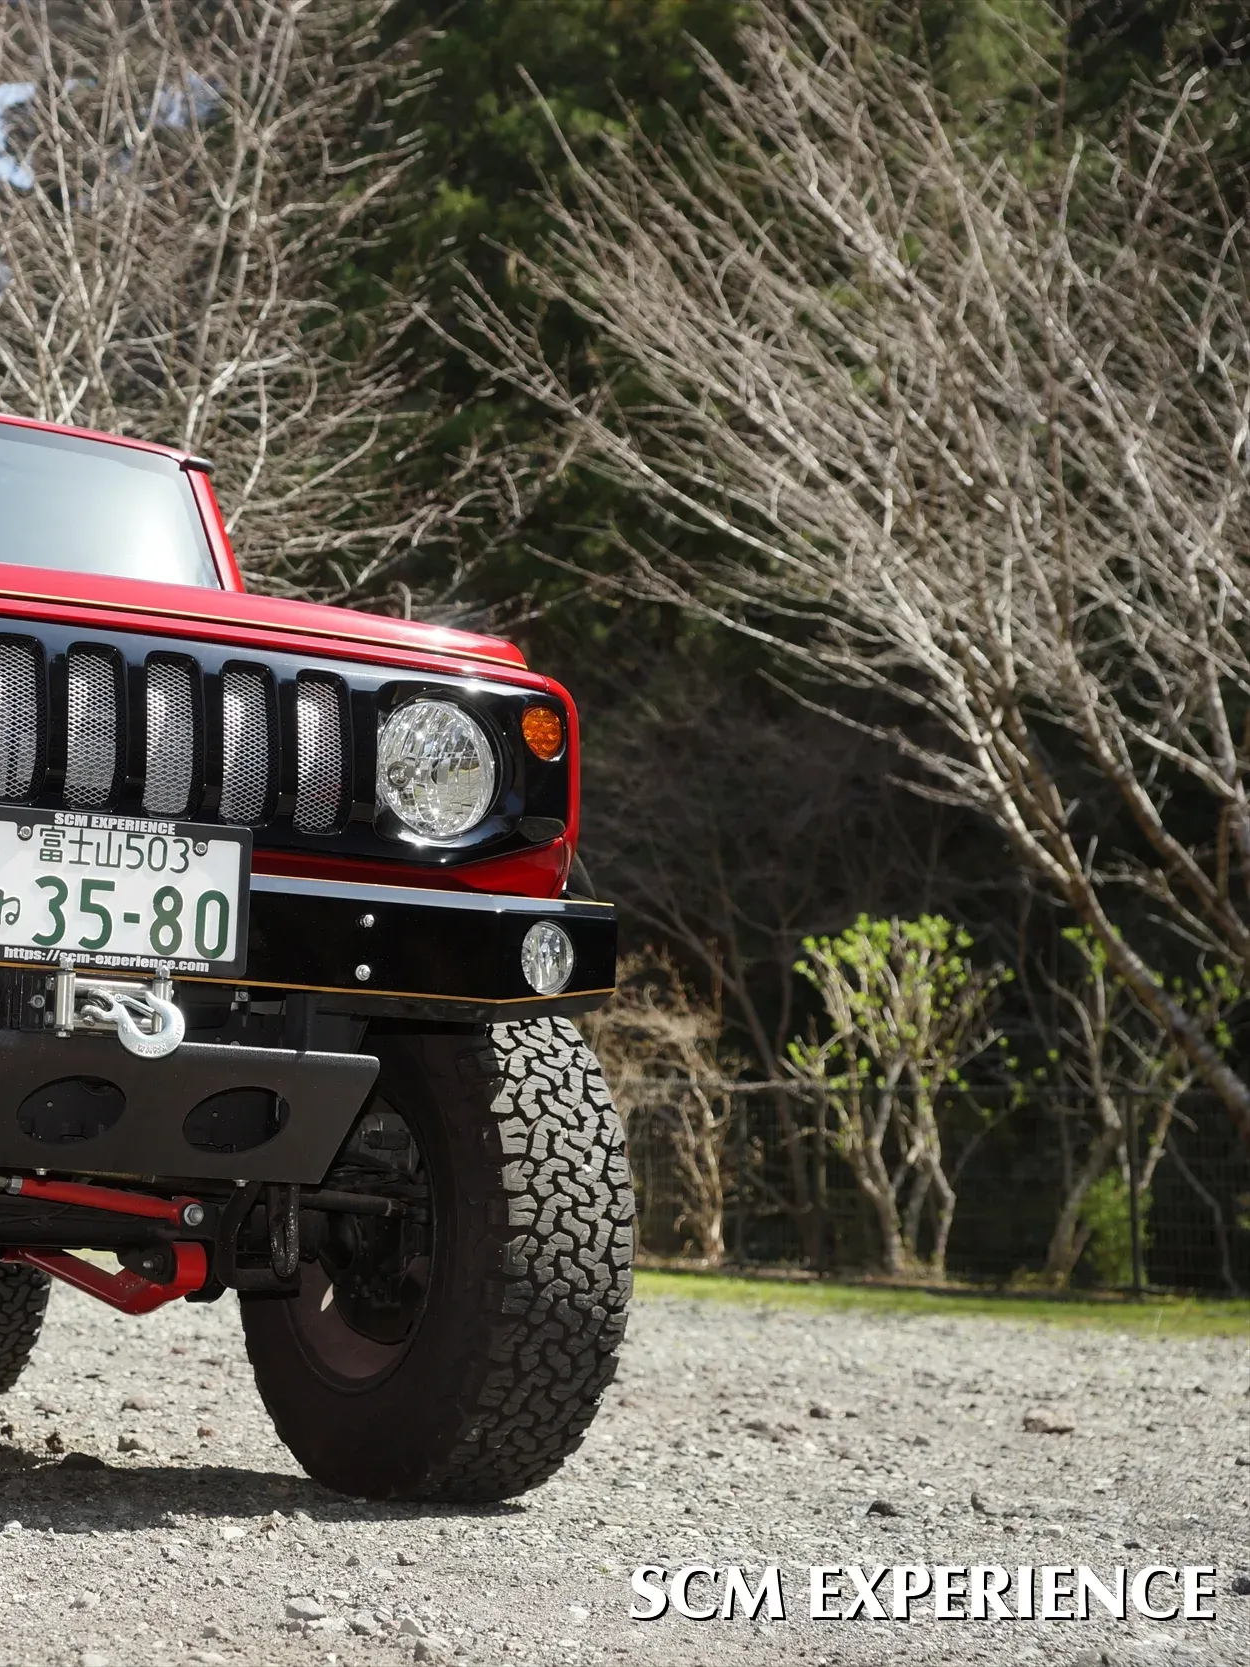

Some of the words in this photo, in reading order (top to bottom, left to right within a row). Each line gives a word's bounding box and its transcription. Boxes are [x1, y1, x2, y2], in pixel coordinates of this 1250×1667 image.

[54, 812, 88, 827] SCM
[90, 815, 176, 836] EXPERIENCE
[39, 826, 190, 874] 富士山503
[31, 875, 230, 959] 35-80
